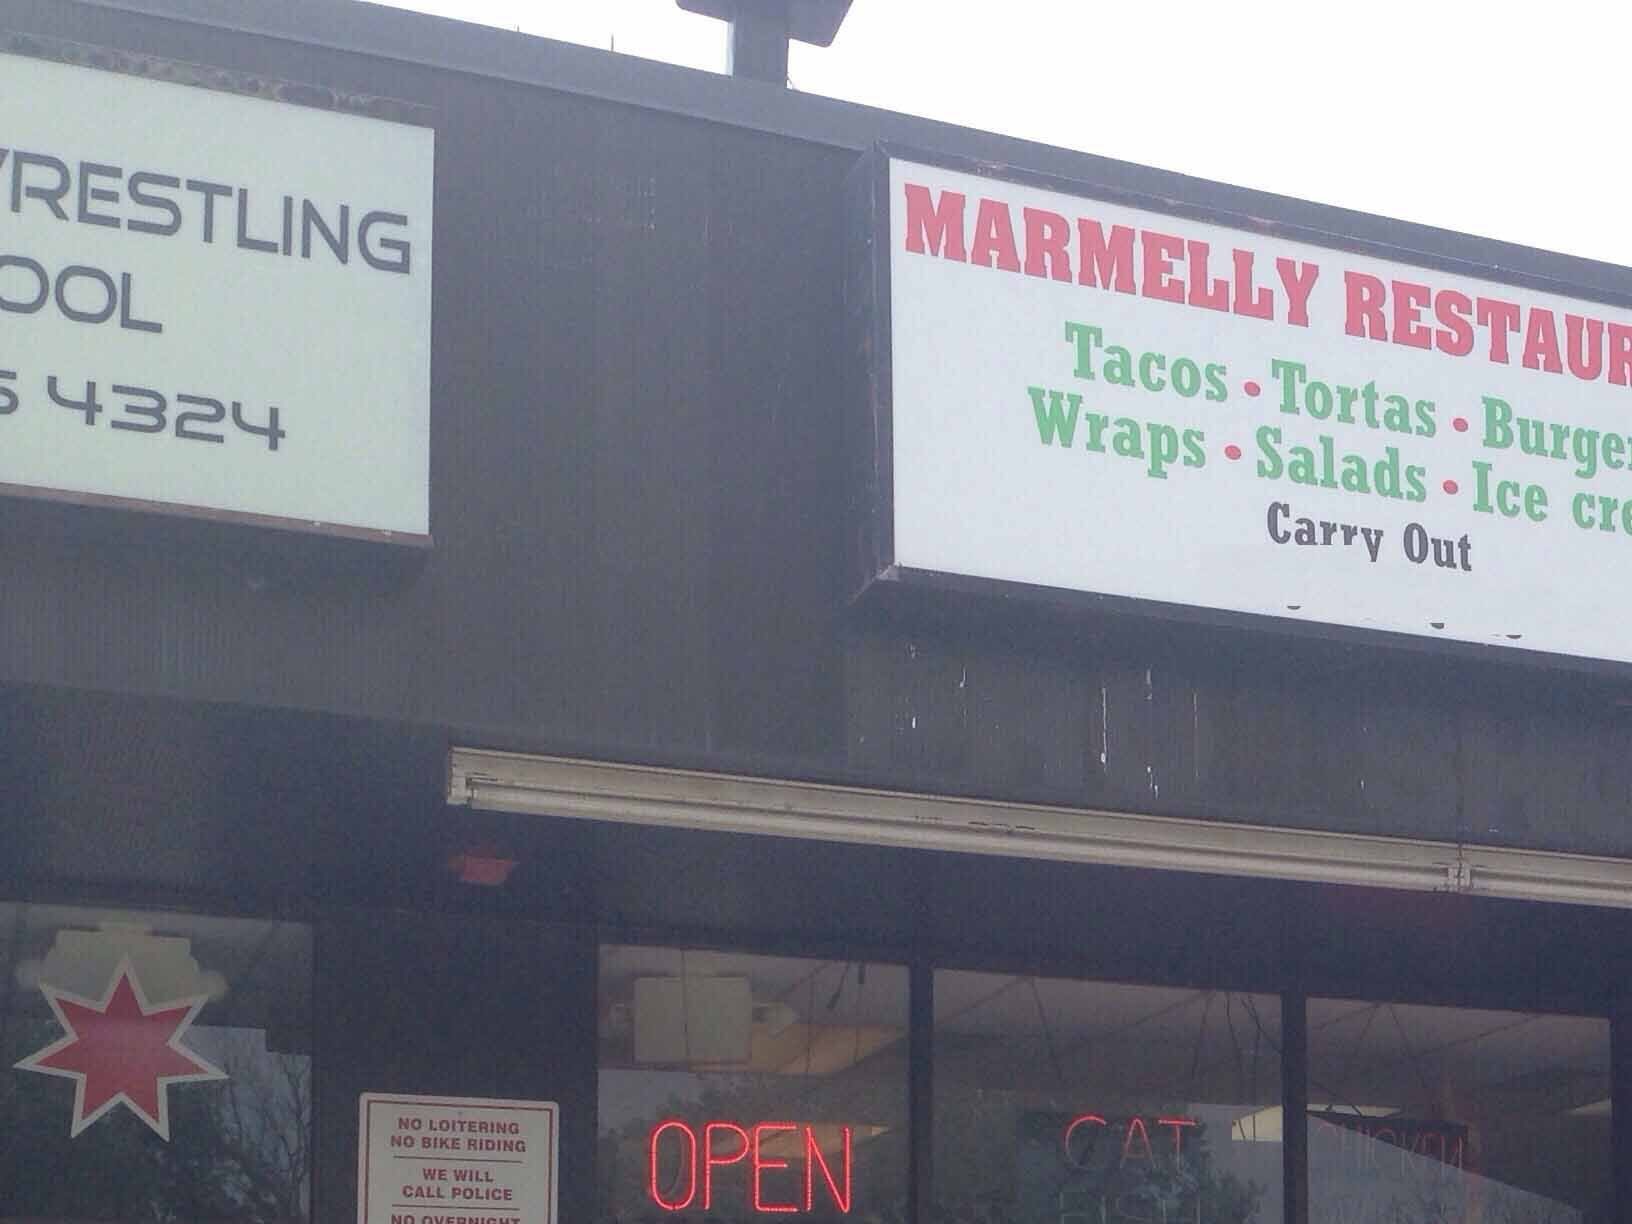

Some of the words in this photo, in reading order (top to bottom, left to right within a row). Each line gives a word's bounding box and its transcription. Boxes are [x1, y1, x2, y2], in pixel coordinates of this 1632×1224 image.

[0, 148, 411, 275] RESTLING
[904, 183, 1319, 327] MARMELLY
[47, 375, 286, 451] 4324
[1064, 320, 1228, 402] Tacos
[1271, 358, 1436, 437] Tortas
[1027, 386, 1206, 479] Wraps
[1256, 426, 1426, 502] Salads
[1472, 460, 1548, 521] Ice
[1267, 502, 1384, 562] Carry
[1403, 523, 1472, 571] Out
[390, 1135, 415, 1148] NO
[421, 1136, 461, 1150] BIKE
[467, 1138, 526, 1153] RIDING
[398, 1117, 422, 1130] NO
[429, 1119, 520, 1135] LOITERING
[1062, 1114, 1198, 1170] CAT
[402, 1185, 445, 1199] CALL
[452, 1187, 513, 1201] POLICE
[423, 1168, 447, 1181] WE
[453, 1169, 495, 1183] WILL
[650, 1120, 852, 1213] OPEN
